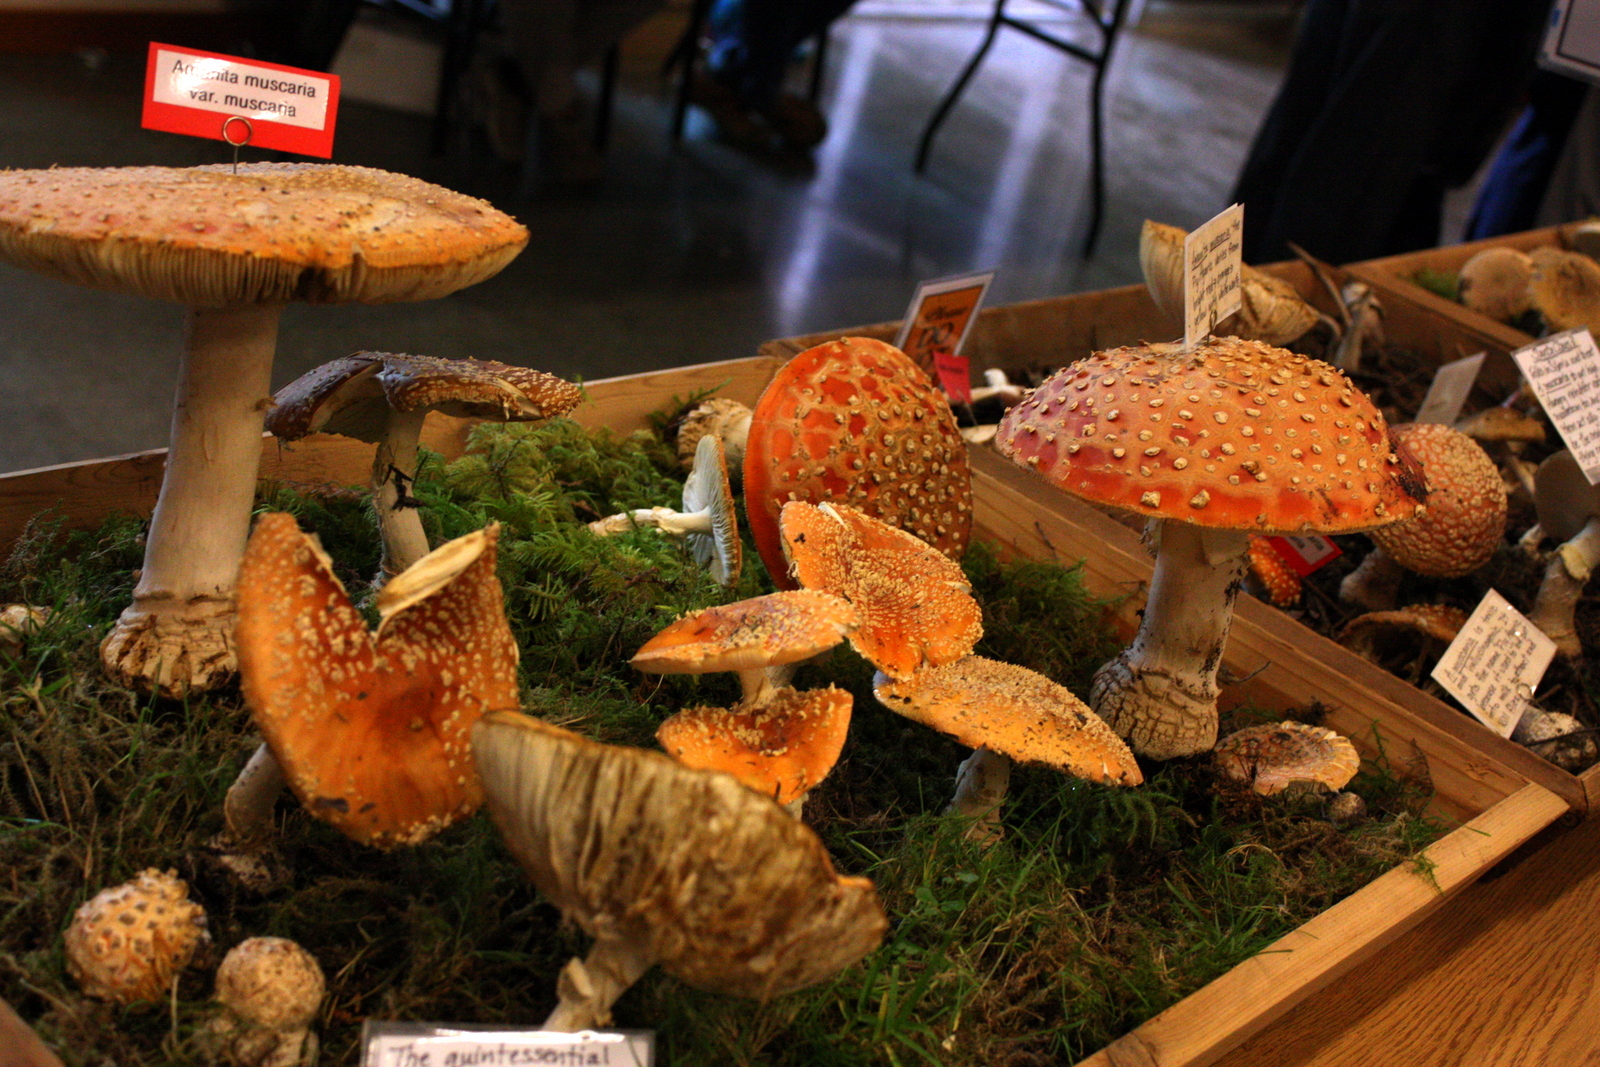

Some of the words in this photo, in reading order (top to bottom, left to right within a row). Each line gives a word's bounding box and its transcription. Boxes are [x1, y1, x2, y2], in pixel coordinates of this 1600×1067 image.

[245, 75, 316, 98] muscaria
[190, 90, 218, 104] var.
[225, 95, 297, 118] muscaria
[389, 1046, 430, 1067] The
